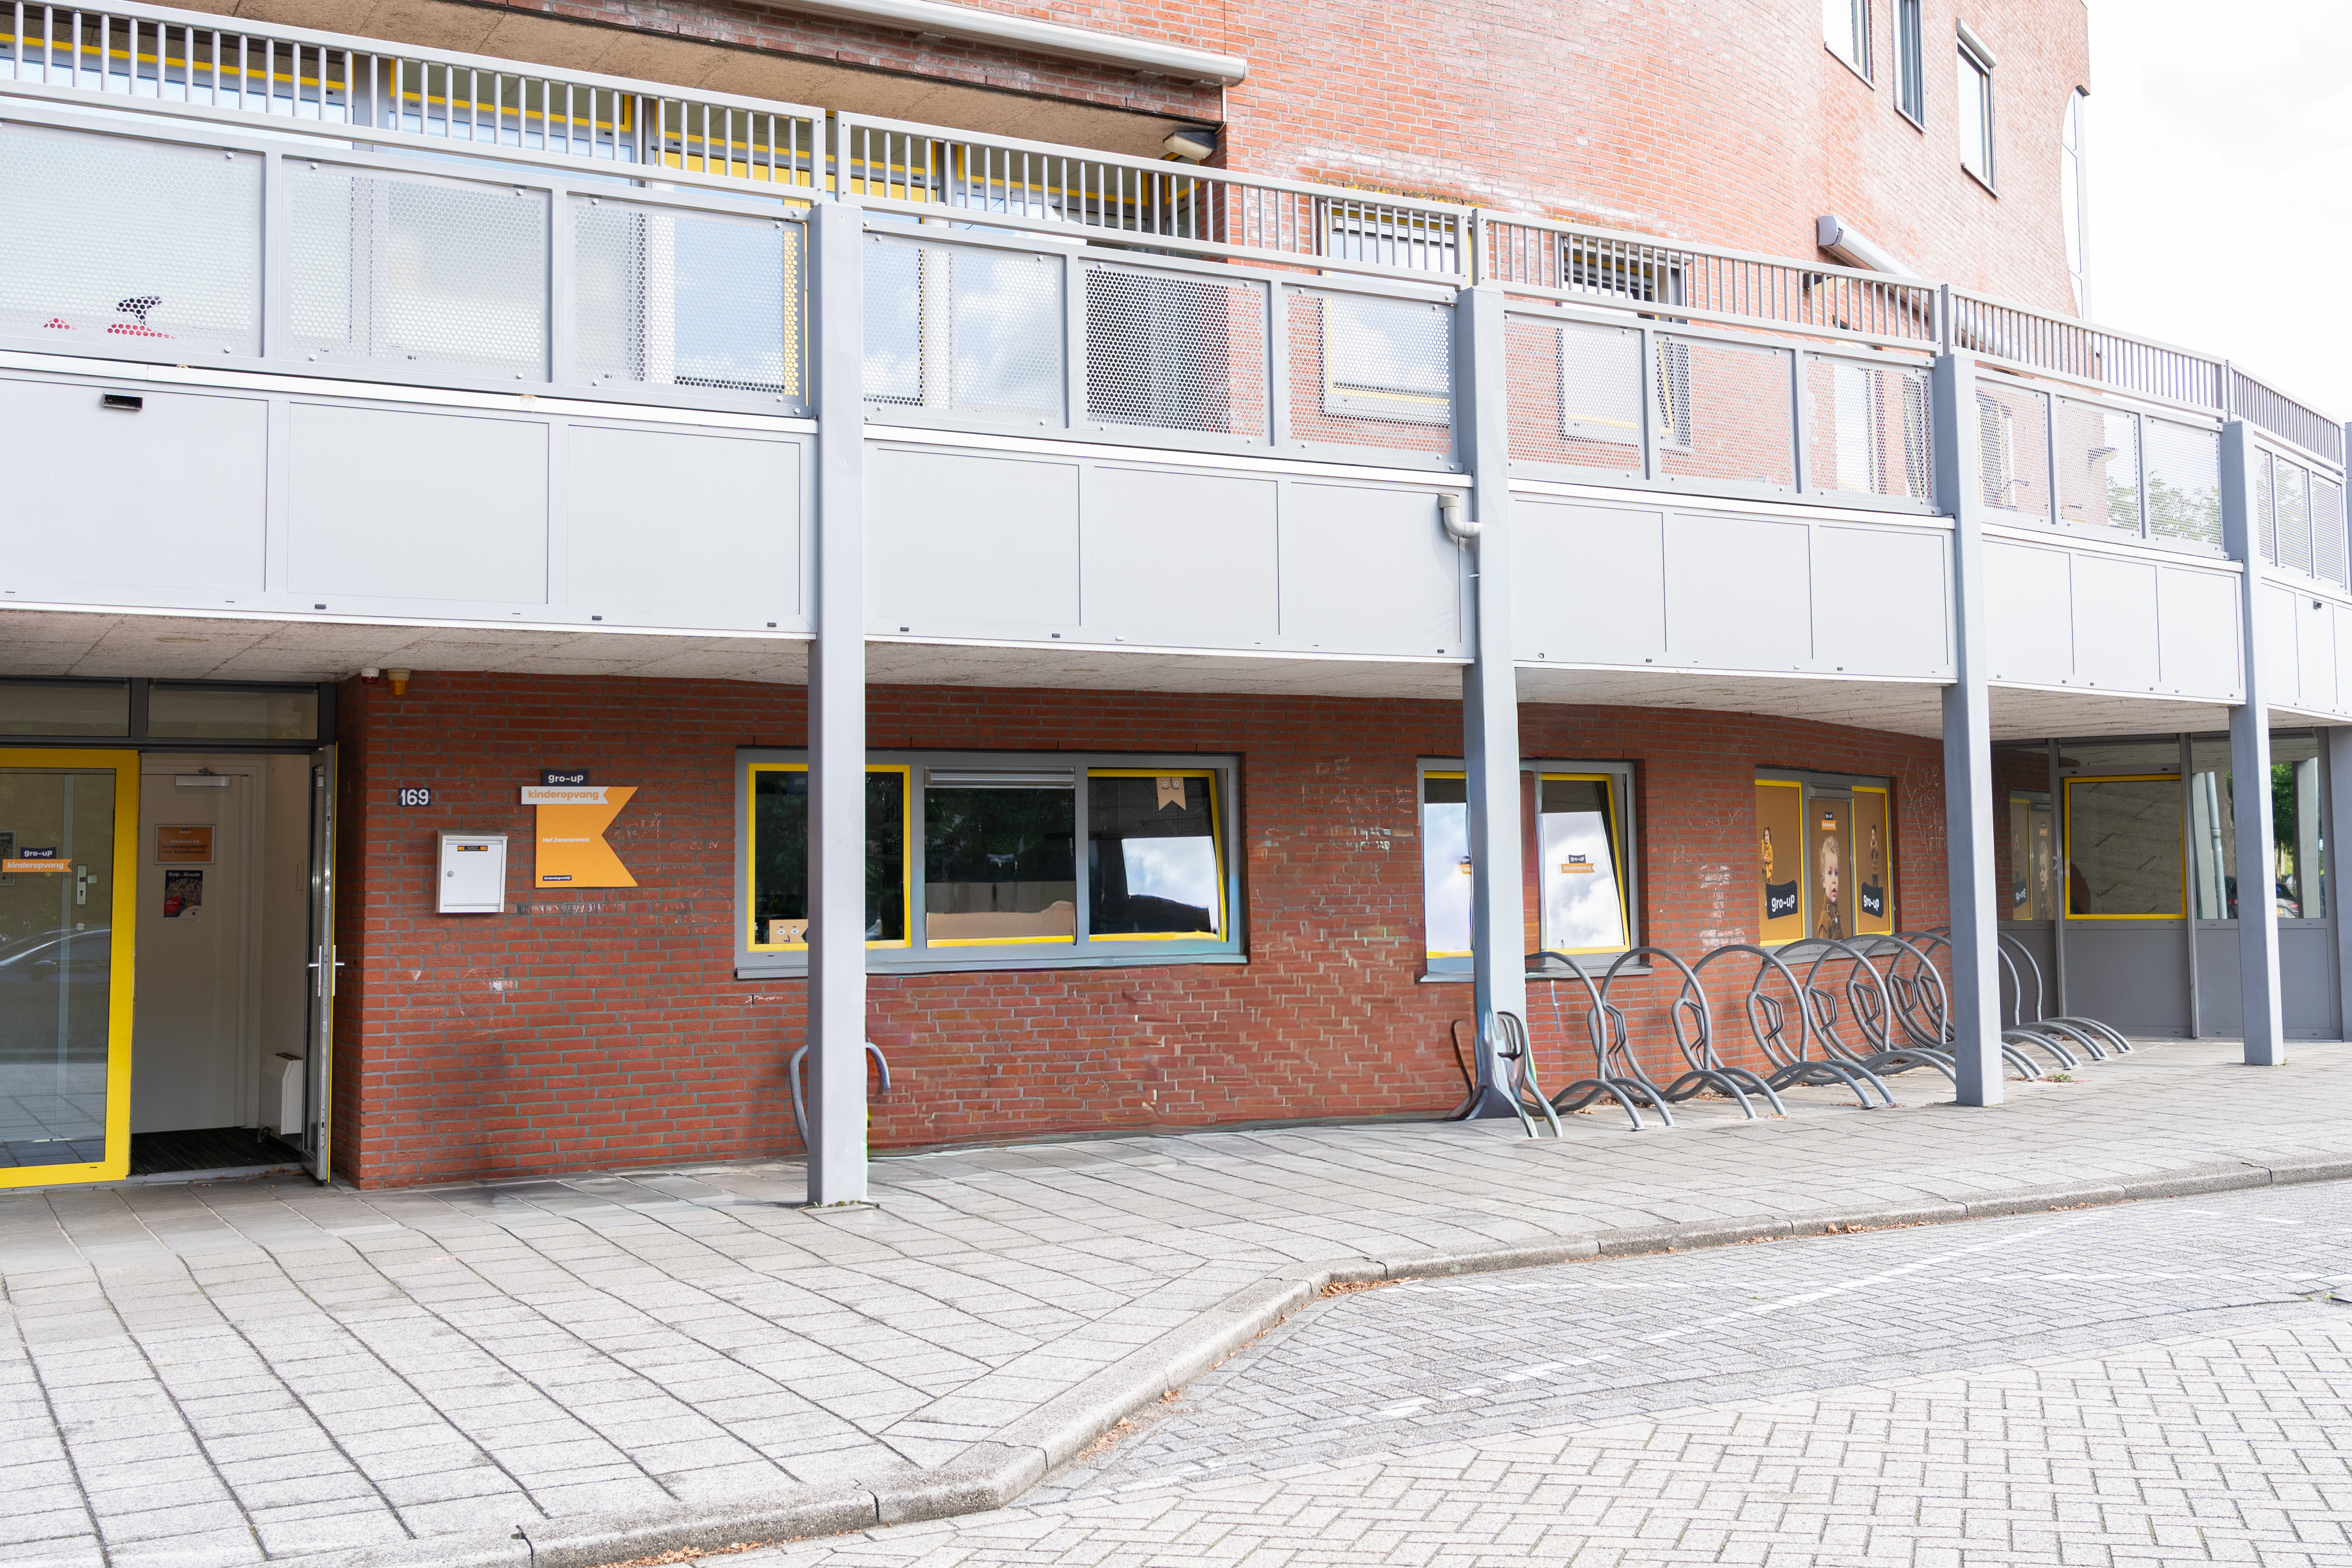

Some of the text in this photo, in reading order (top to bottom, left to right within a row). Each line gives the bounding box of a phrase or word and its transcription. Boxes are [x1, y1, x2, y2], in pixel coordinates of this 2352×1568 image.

[548, 775, 583, 783] gro-up
[401, 789, 429, 805] 169
[528, 790, 599, 801] kinderopvang
[1771, 894, 1795, 912] gro-up
[1863, 895, 1879, 911] gro-up
